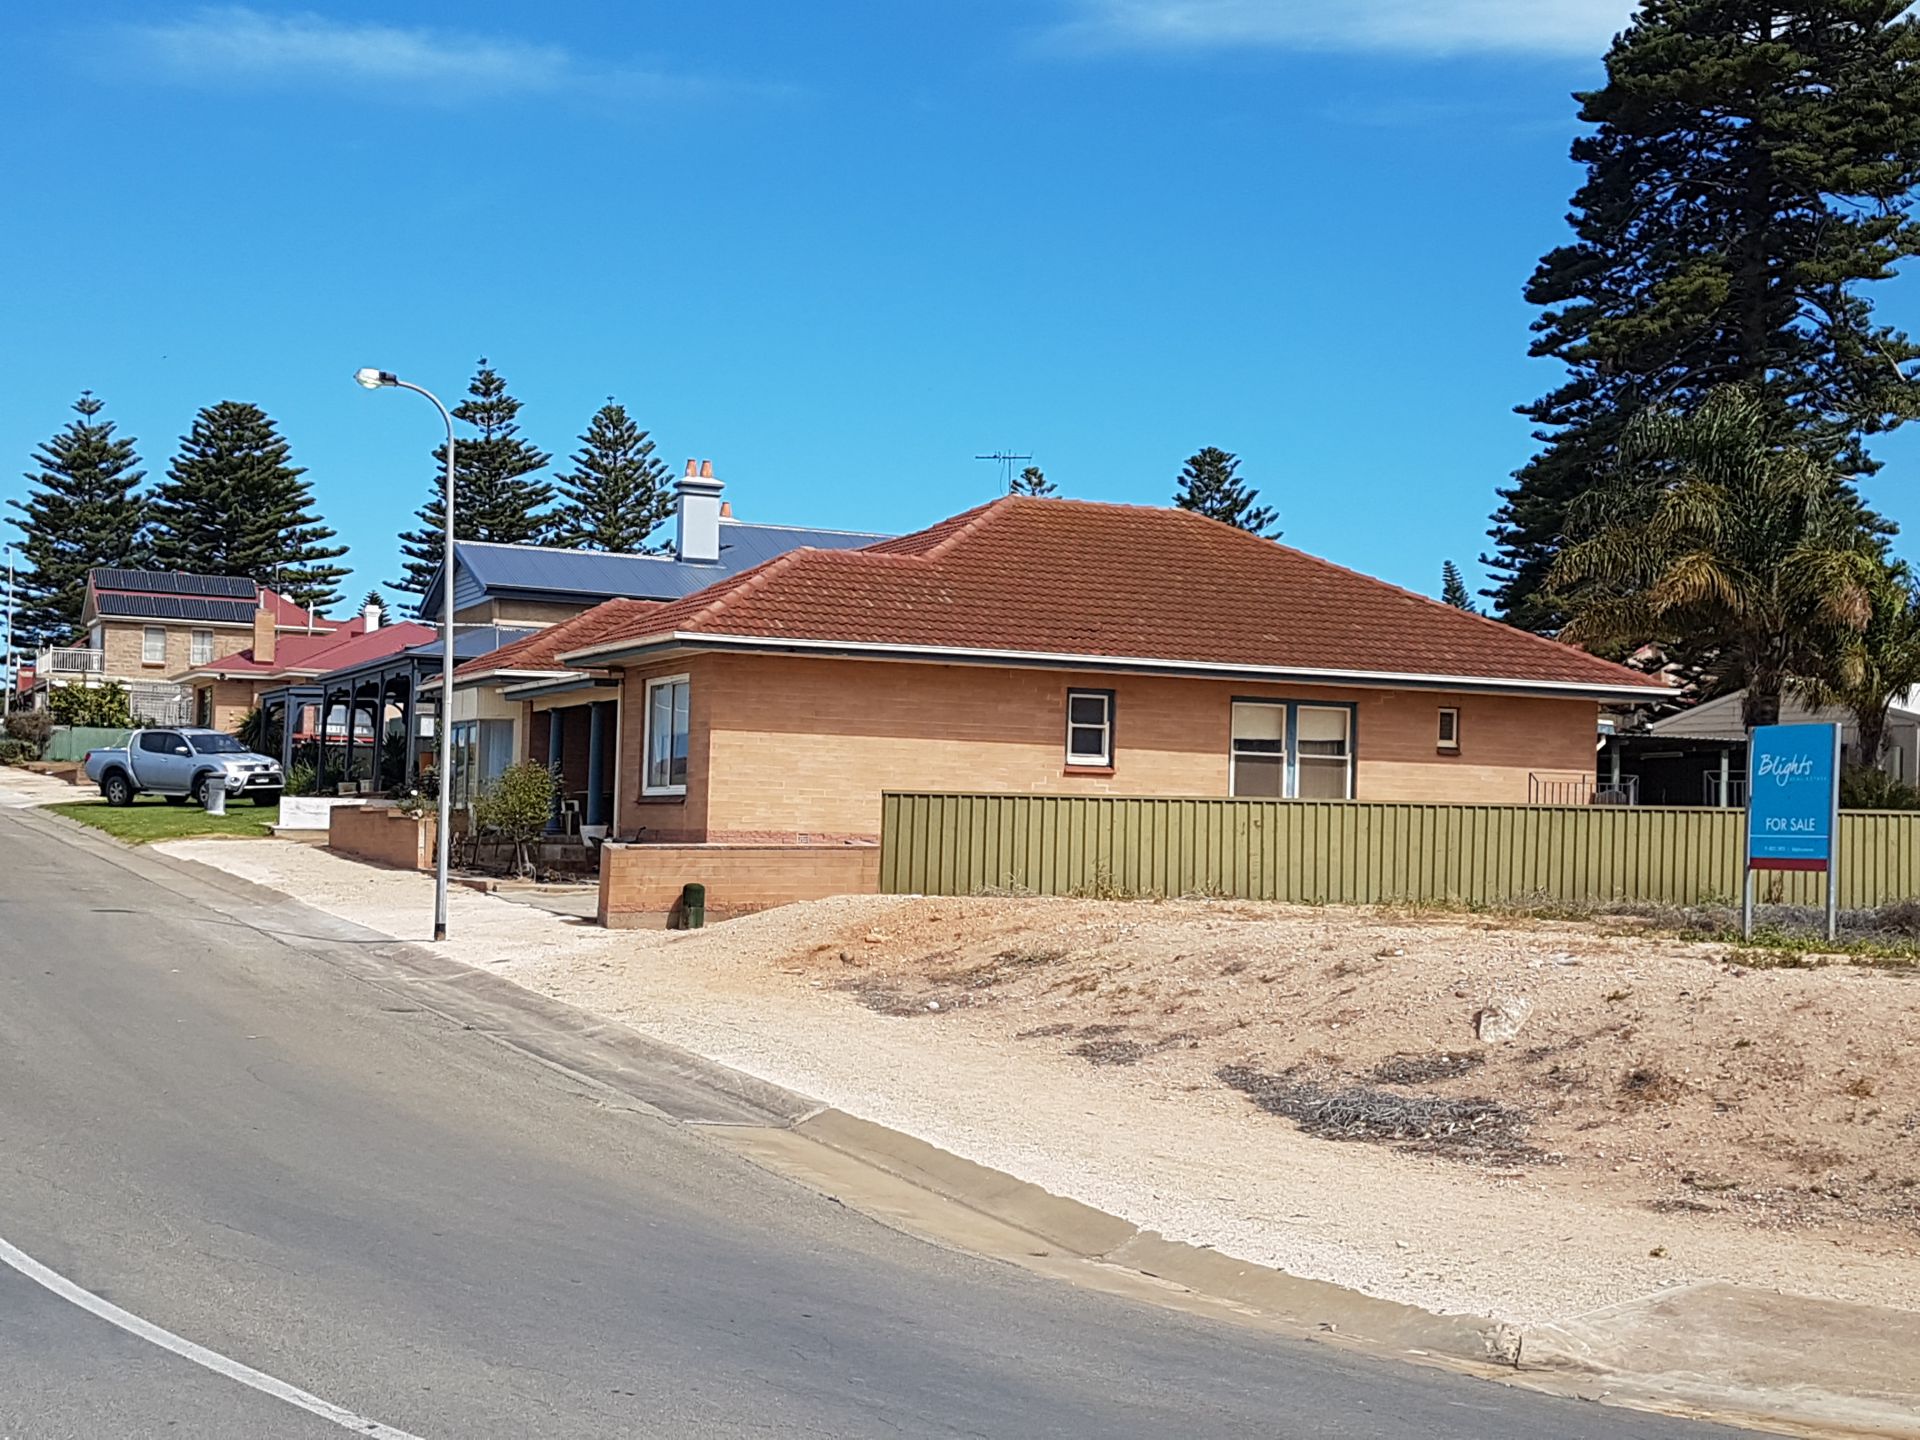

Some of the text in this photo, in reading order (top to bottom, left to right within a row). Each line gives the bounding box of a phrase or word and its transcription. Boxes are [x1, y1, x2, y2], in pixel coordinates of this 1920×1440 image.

[1758, 754, 1813, 787] Blights
[1765, 817, 1816, 832] FOR SALE
